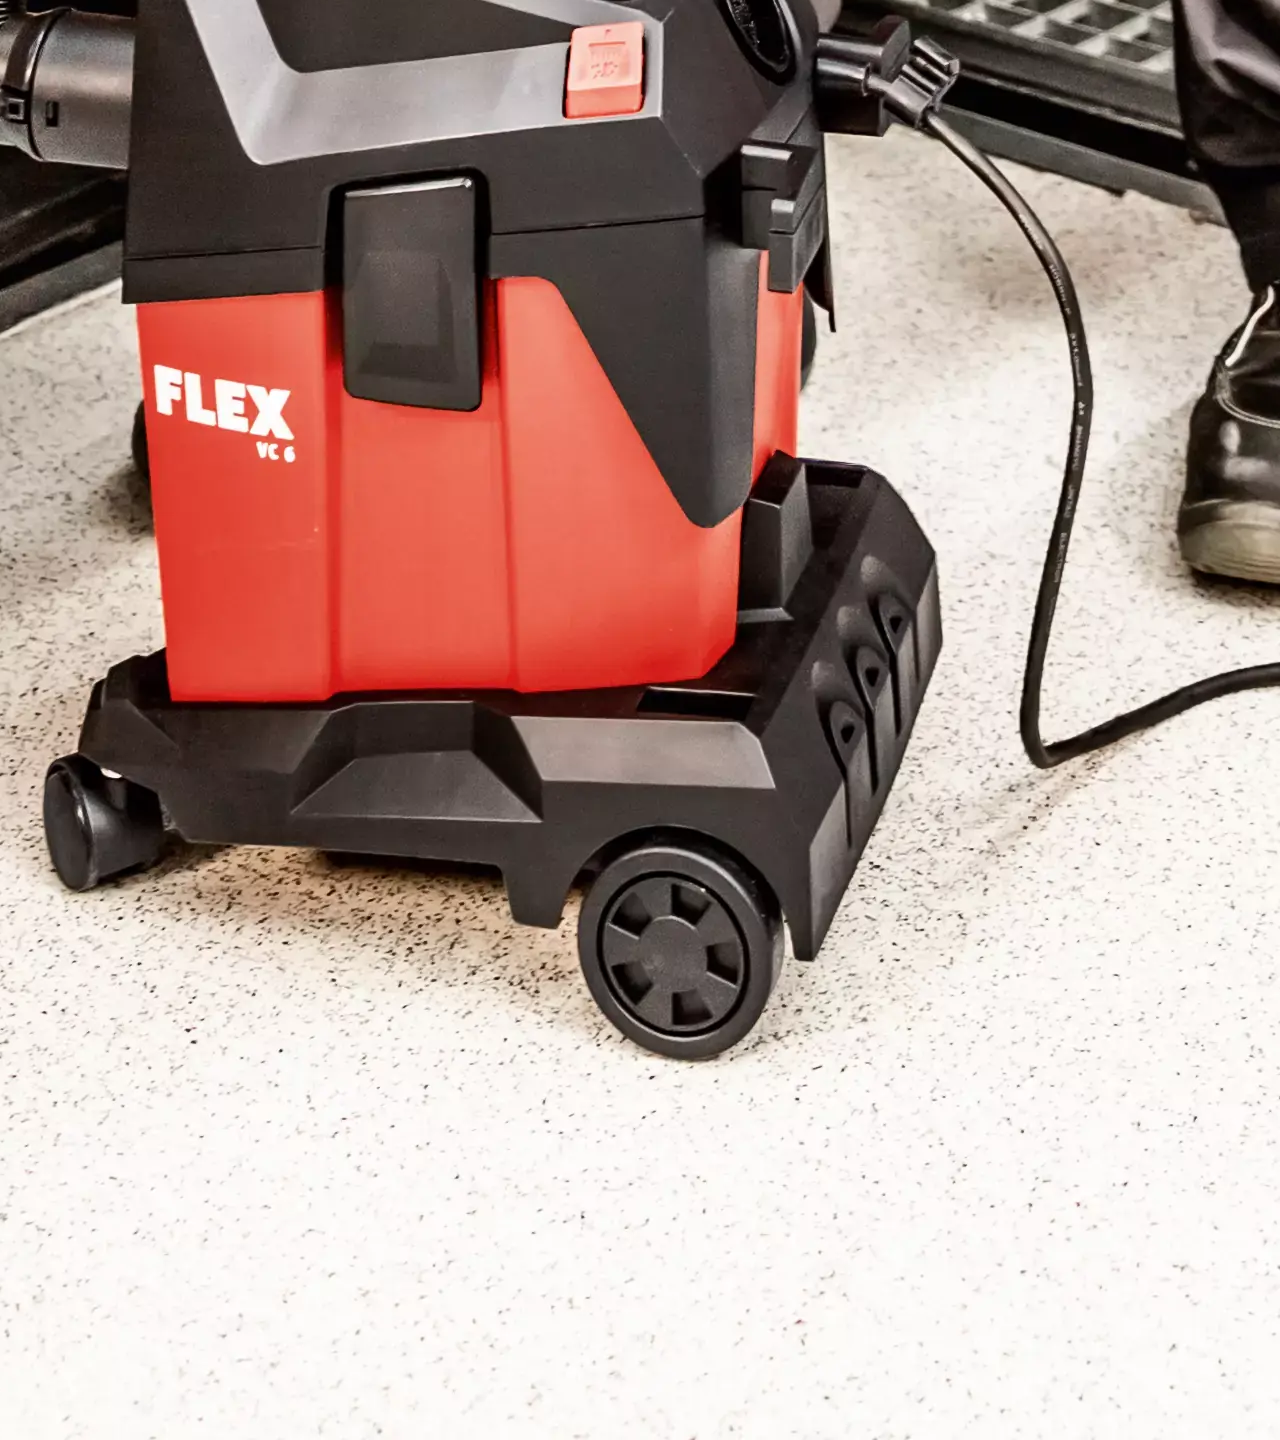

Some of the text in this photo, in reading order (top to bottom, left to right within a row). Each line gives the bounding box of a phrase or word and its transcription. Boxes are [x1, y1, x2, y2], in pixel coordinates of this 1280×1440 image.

[153, 364, 295, 440] FLEX
[255, 441, 296, 463] VC 6
